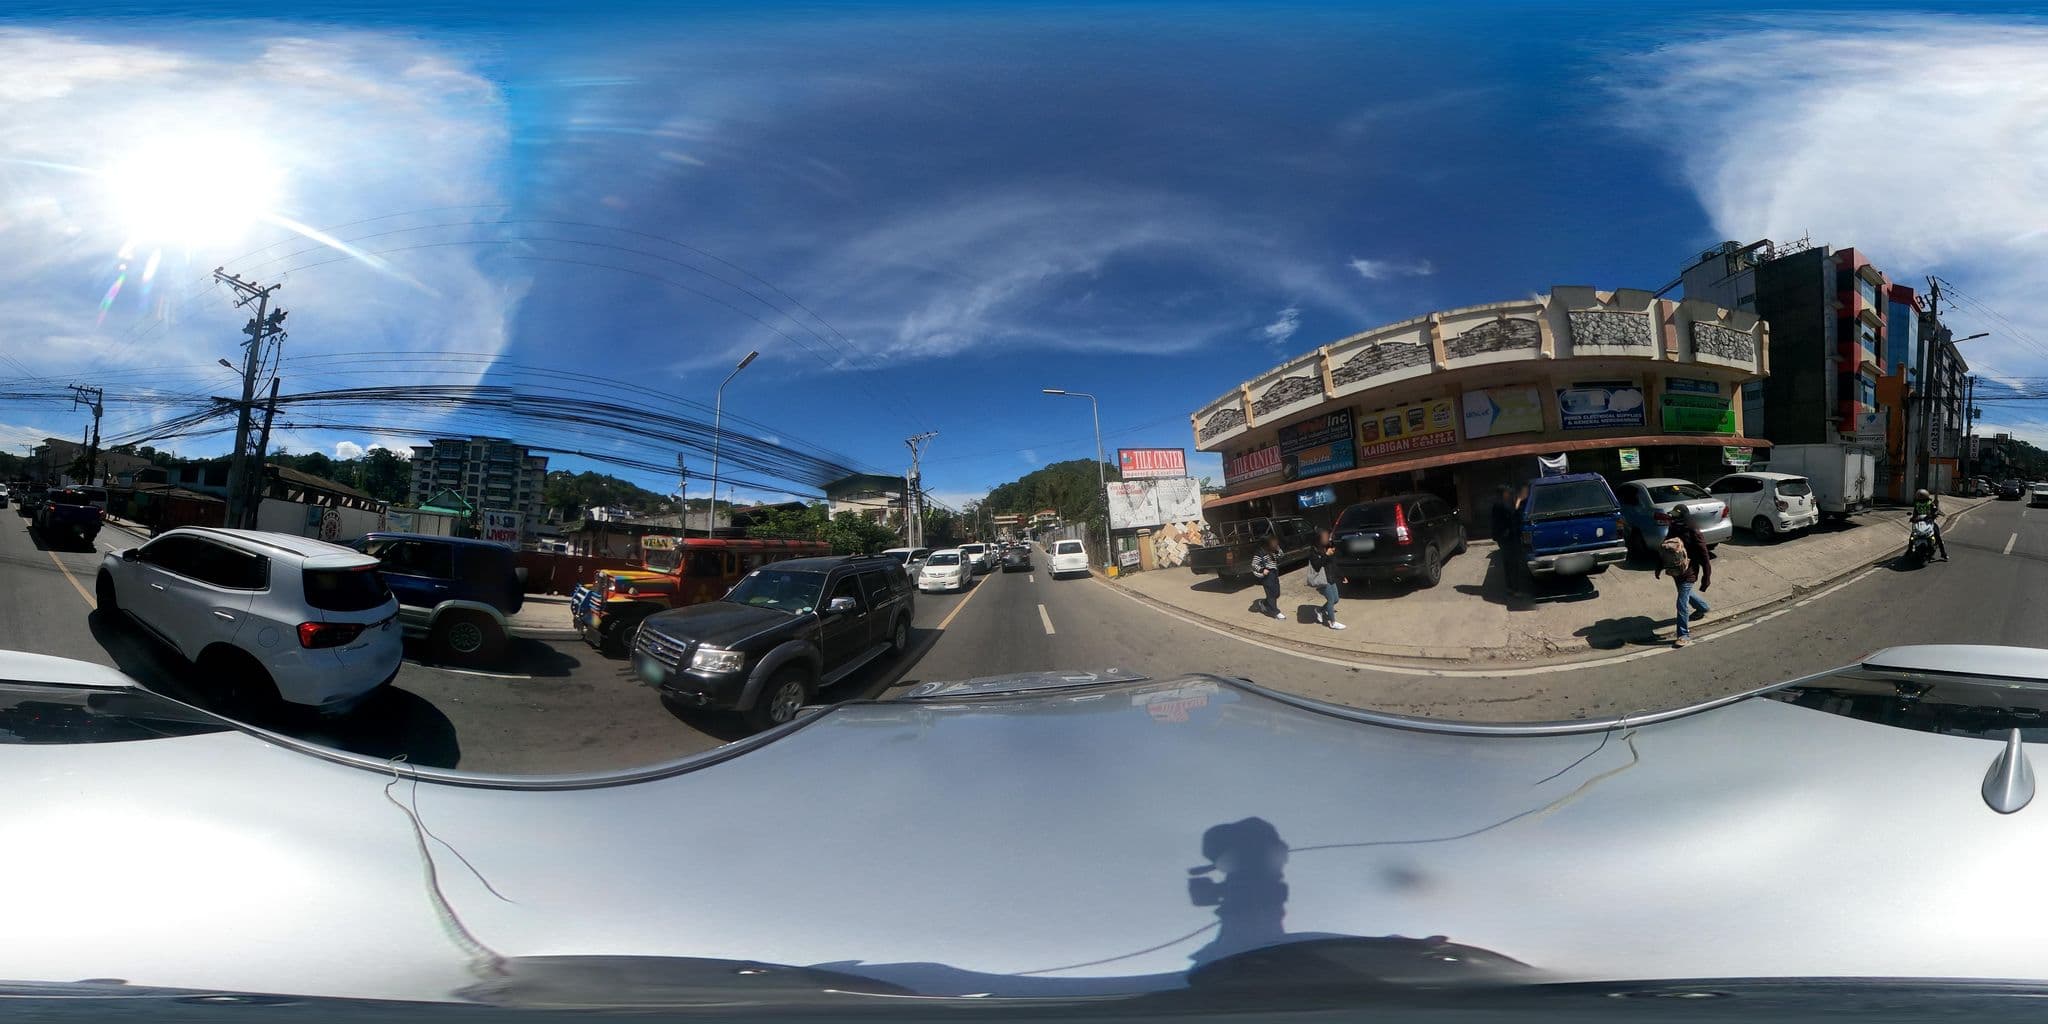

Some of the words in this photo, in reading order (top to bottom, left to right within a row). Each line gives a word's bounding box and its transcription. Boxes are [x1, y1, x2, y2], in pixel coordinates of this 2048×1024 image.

[1328, 414, 1348, 428] Inc
[1411, 431, 1454, 443] PAINT
[1412, 435, 1454, 448] CENTER
[1363, 439, 1410, 457] KAIBIGAN
[1135, 450, 1151, 469] TILE
[1153, 450, 1184, 468] CENTER
[1232, 455, 1249, 475] TILE
[1249, 446, 1281, 470] CENTER
